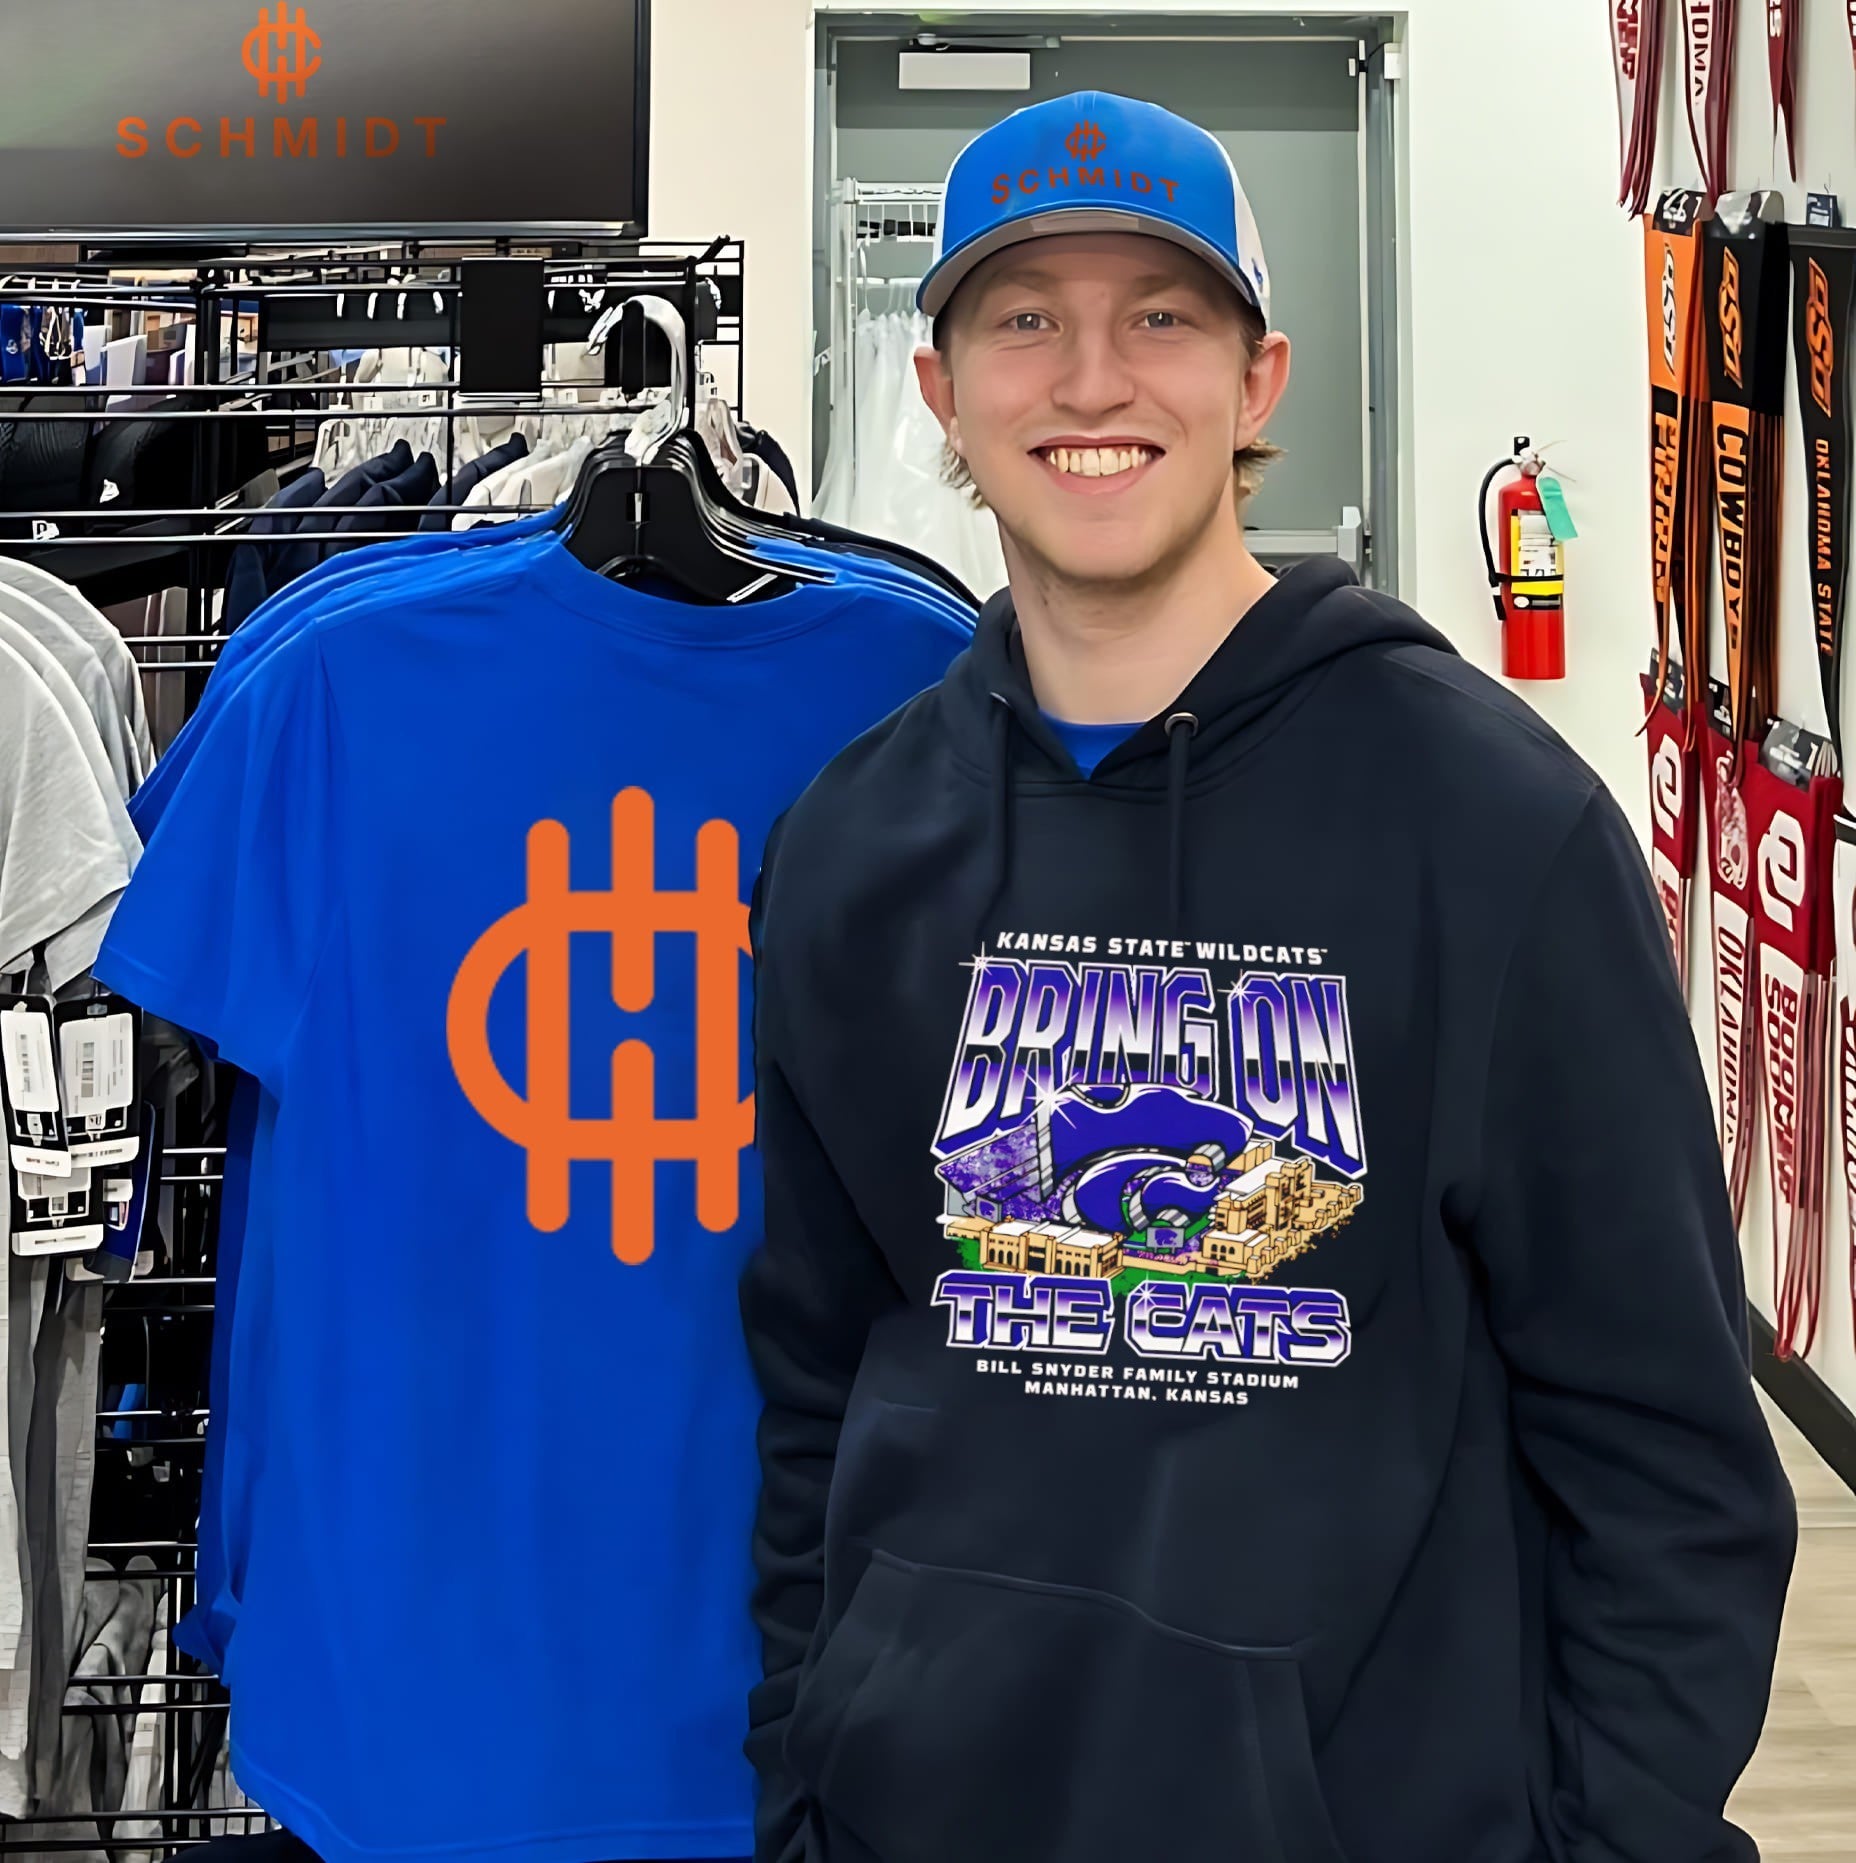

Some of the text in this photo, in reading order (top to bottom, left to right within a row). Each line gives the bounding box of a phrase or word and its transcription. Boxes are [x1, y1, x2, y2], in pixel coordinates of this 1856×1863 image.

[115, 116, 448, 159] SCHMIDT
[991, 166, 1180, 205] SCHMIDT
[1815, 438, 1832, 571] OKLAHOMA
[996, 931, 1325, 966] KANSAS STATE WILDCATS
[1717, 924, 1745, 1145] OKLAHOMA
[929, 957, 1368, 1180] BRING ON
[929, 1269, 1352, 1367] THE CATS
[976, 1359, 1299, 1389] BILL SNYDER FAMILY STADIUM
[1166, 1388, 1249, 1405] KANSAS
